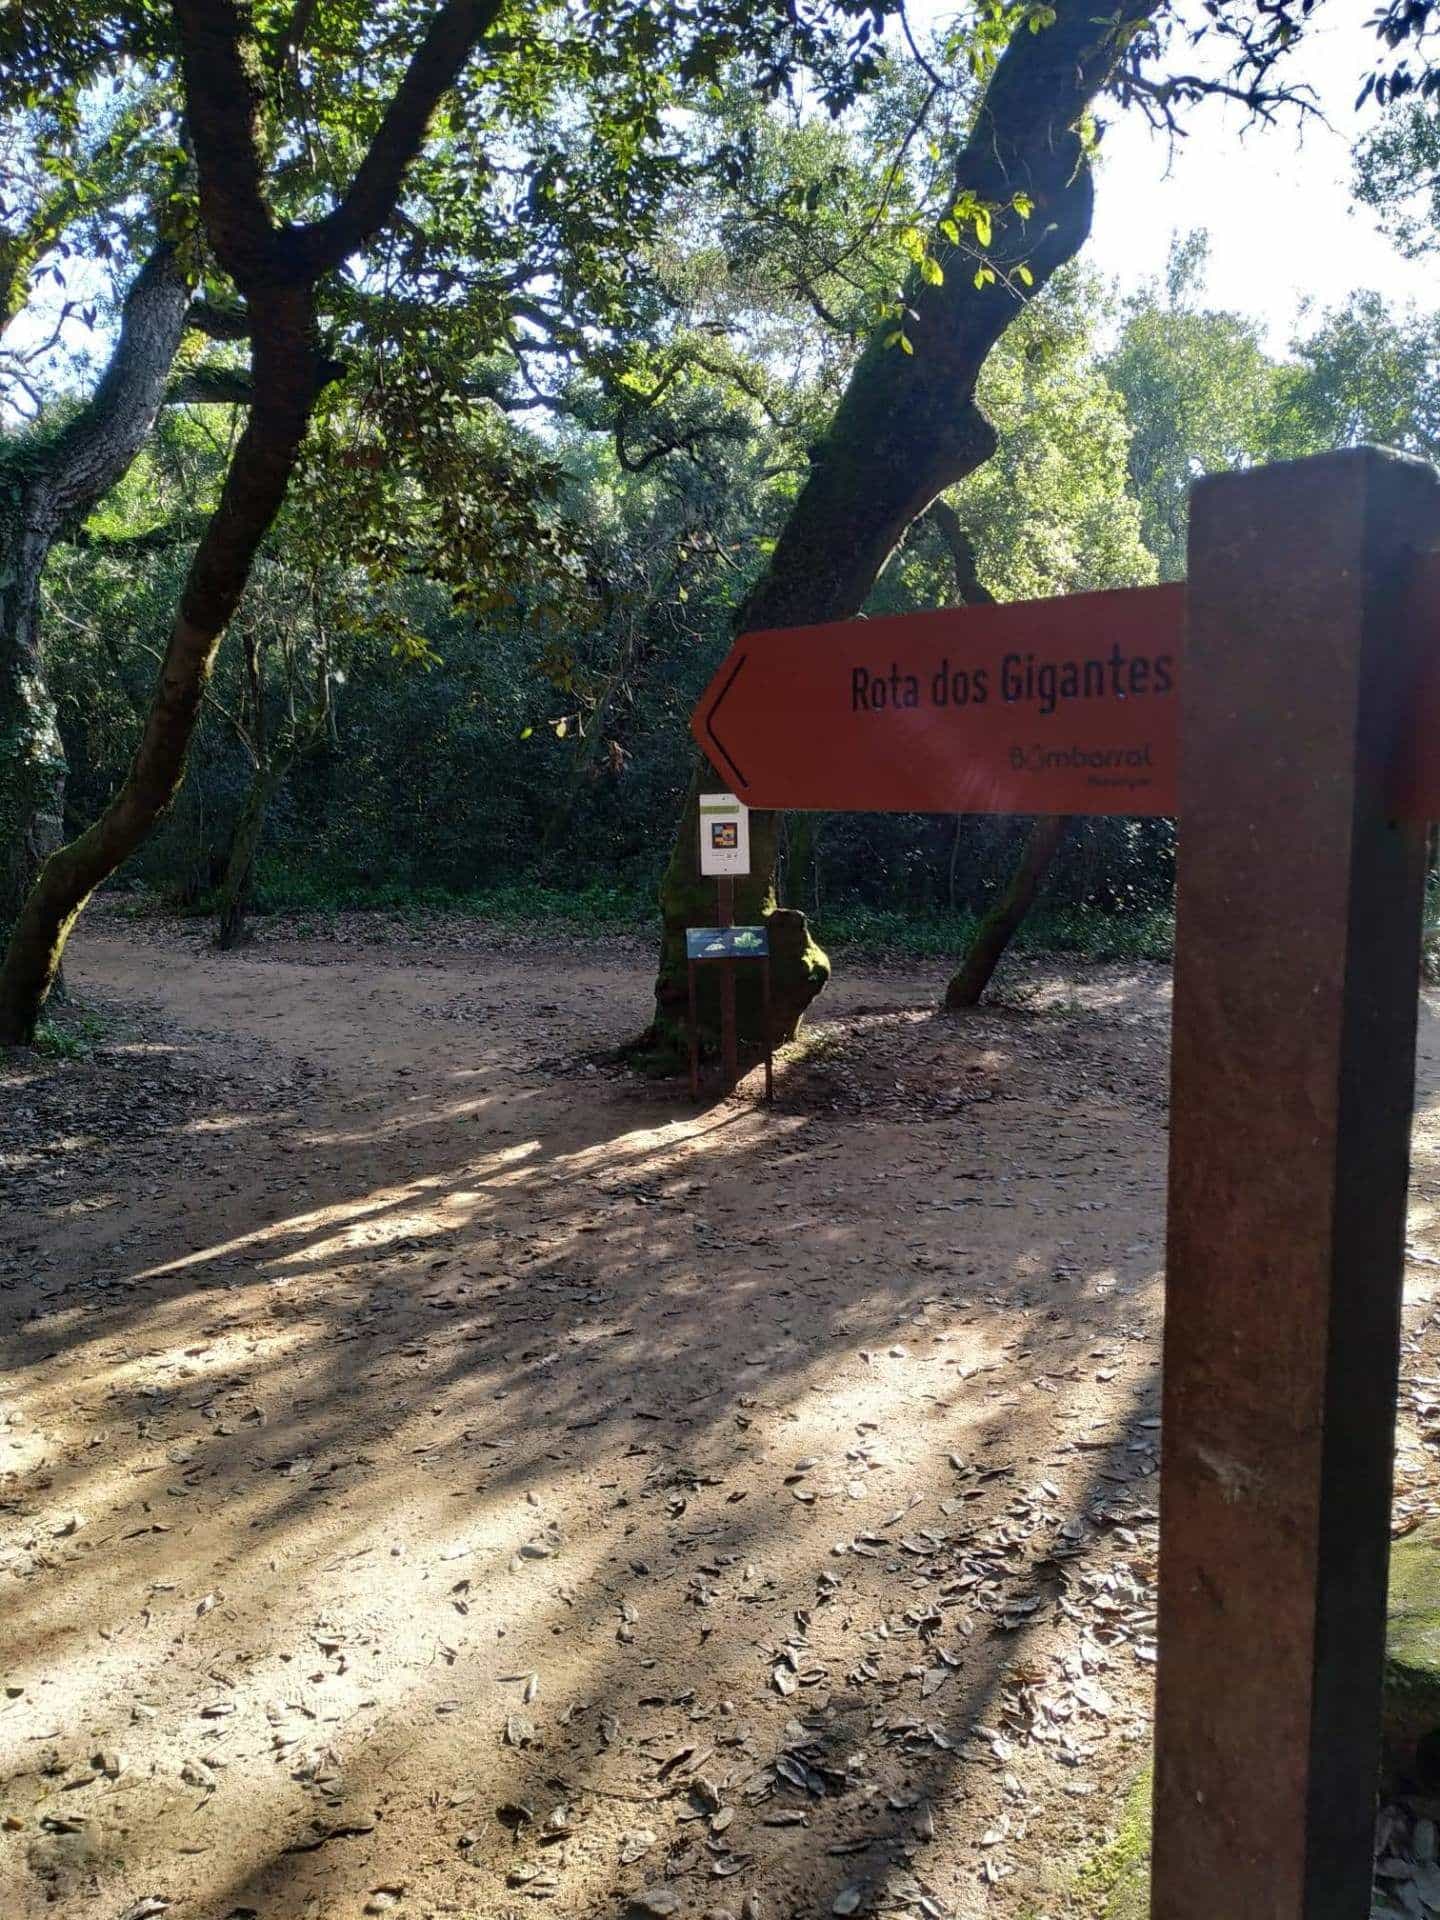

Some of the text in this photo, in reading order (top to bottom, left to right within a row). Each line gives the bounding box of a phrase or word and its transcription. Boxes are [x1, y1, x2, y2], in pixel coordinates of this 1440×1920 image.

[852, 643, 1173, 714] Rota dos Gigantes
